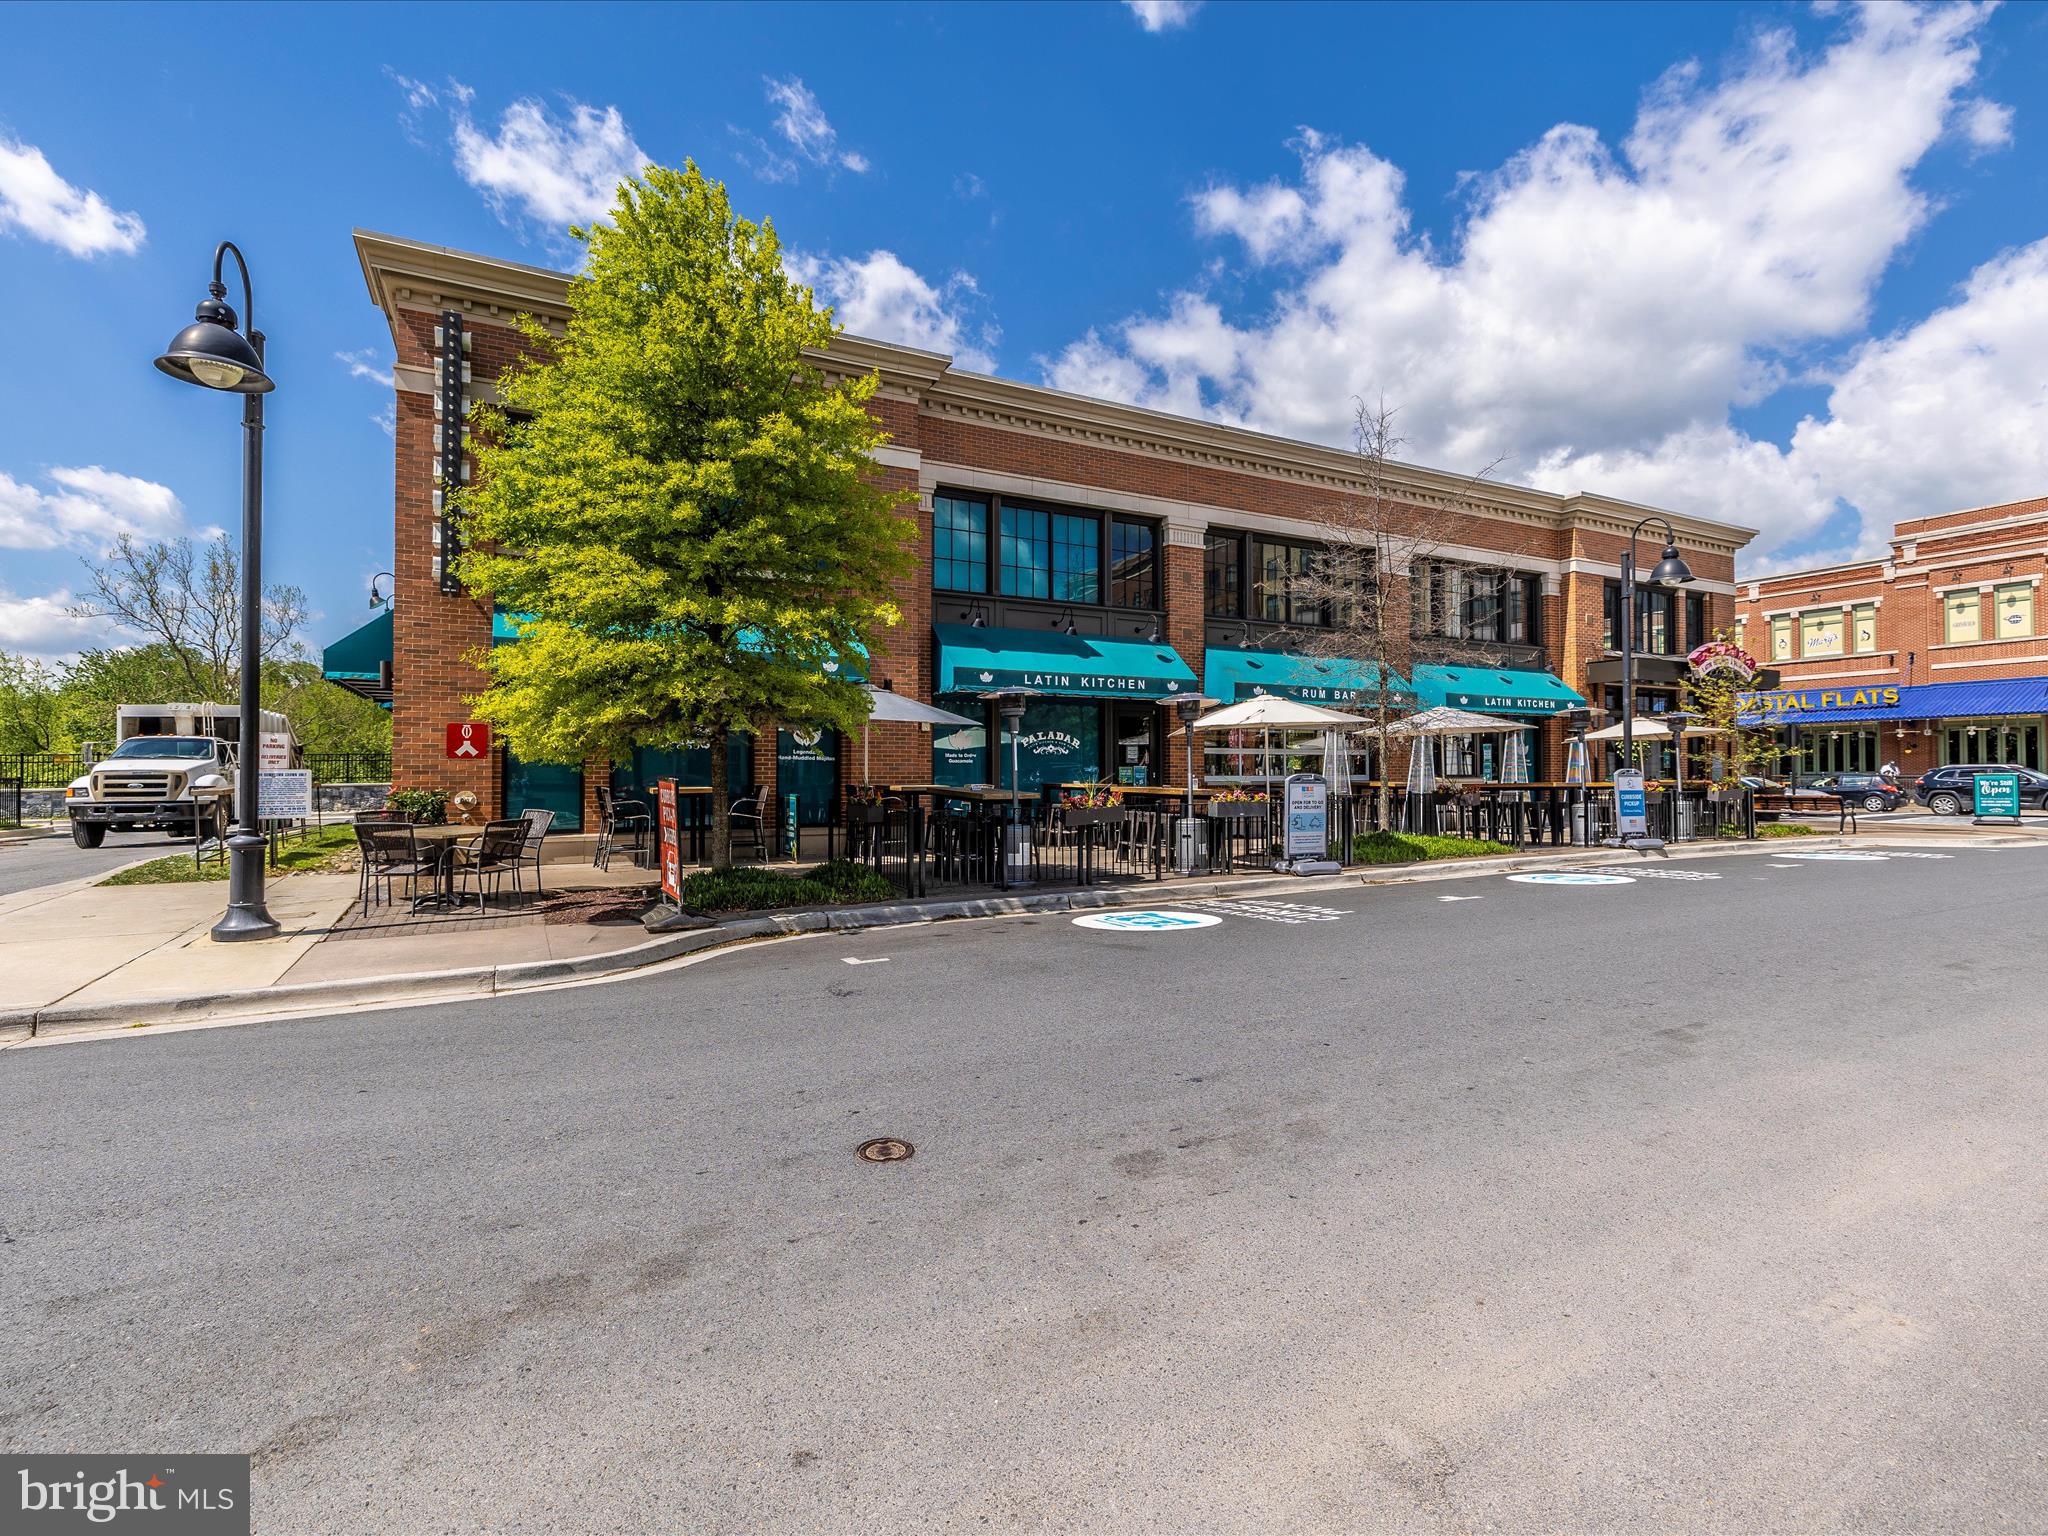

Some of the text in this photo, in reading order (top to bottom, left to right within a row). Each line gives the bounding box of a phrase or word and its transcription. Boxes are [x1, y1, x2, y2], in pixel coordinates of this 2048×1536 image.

[1024, 674, 1146, 689] LATIN KITCHEN
[1302, 688, 1356, 700] RUM BAR
[1821, 687, 1899, 707] FLATS
[1484, 697, 1556, 709] LATIN KITCHEN
[1021, 731, 1080, 749] PALADAR
[1981, 786, 2012, 796] Open
